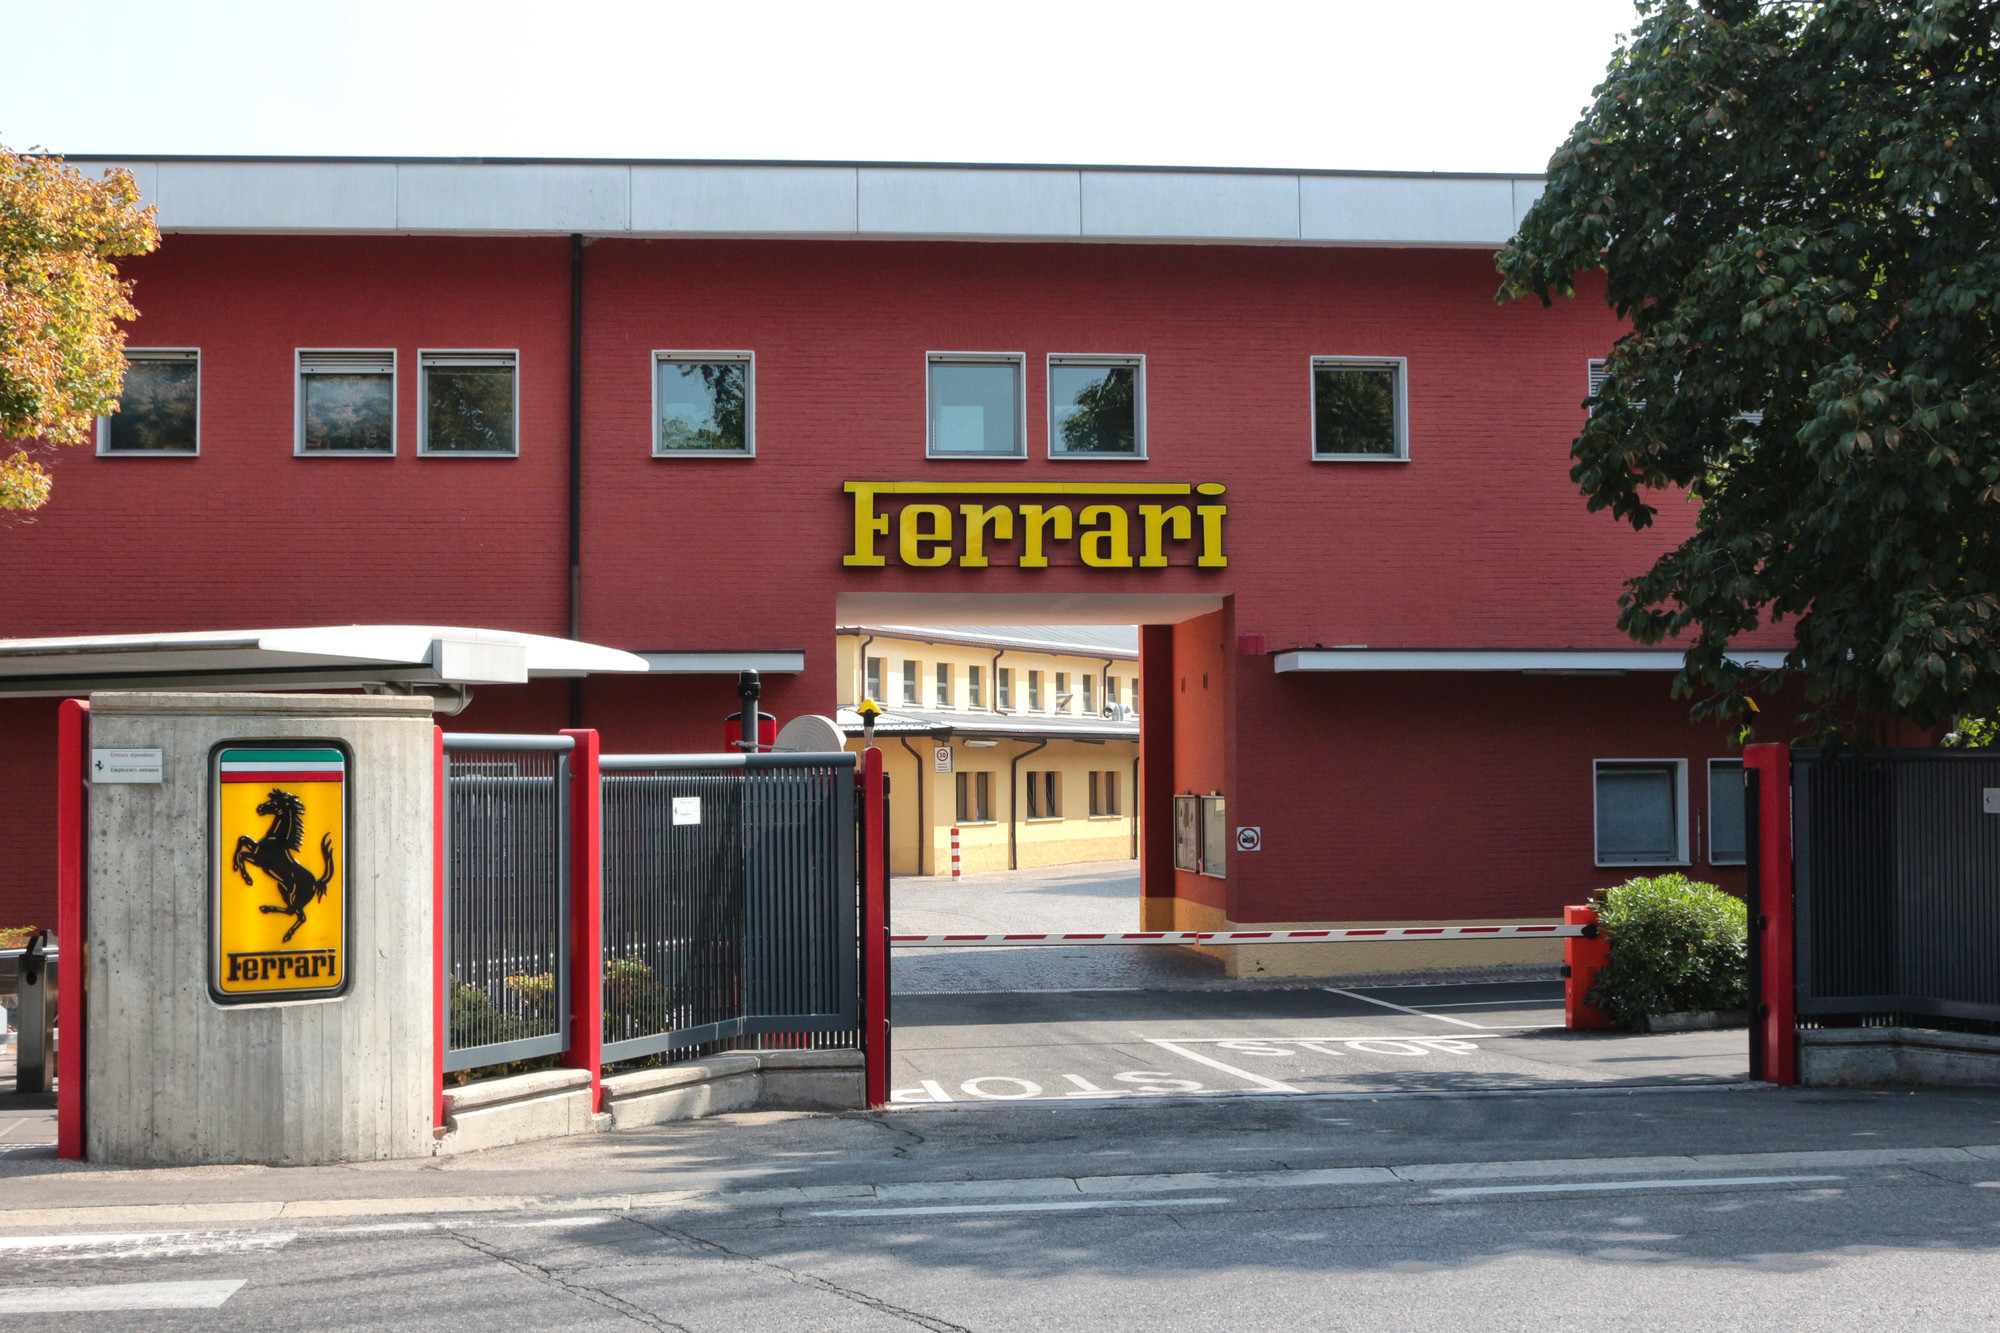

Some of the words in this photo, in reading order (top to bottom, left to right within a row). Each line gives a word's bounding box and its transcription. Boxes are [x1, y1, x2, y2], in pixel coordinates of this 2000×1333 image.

[843, 481, 1228, 568] Ferrari
[227, 947, 337, 982] Ferrari
[1216, 1040, 1479, 1056] STOP
[890, 1071, 1204, 1102] STOP
